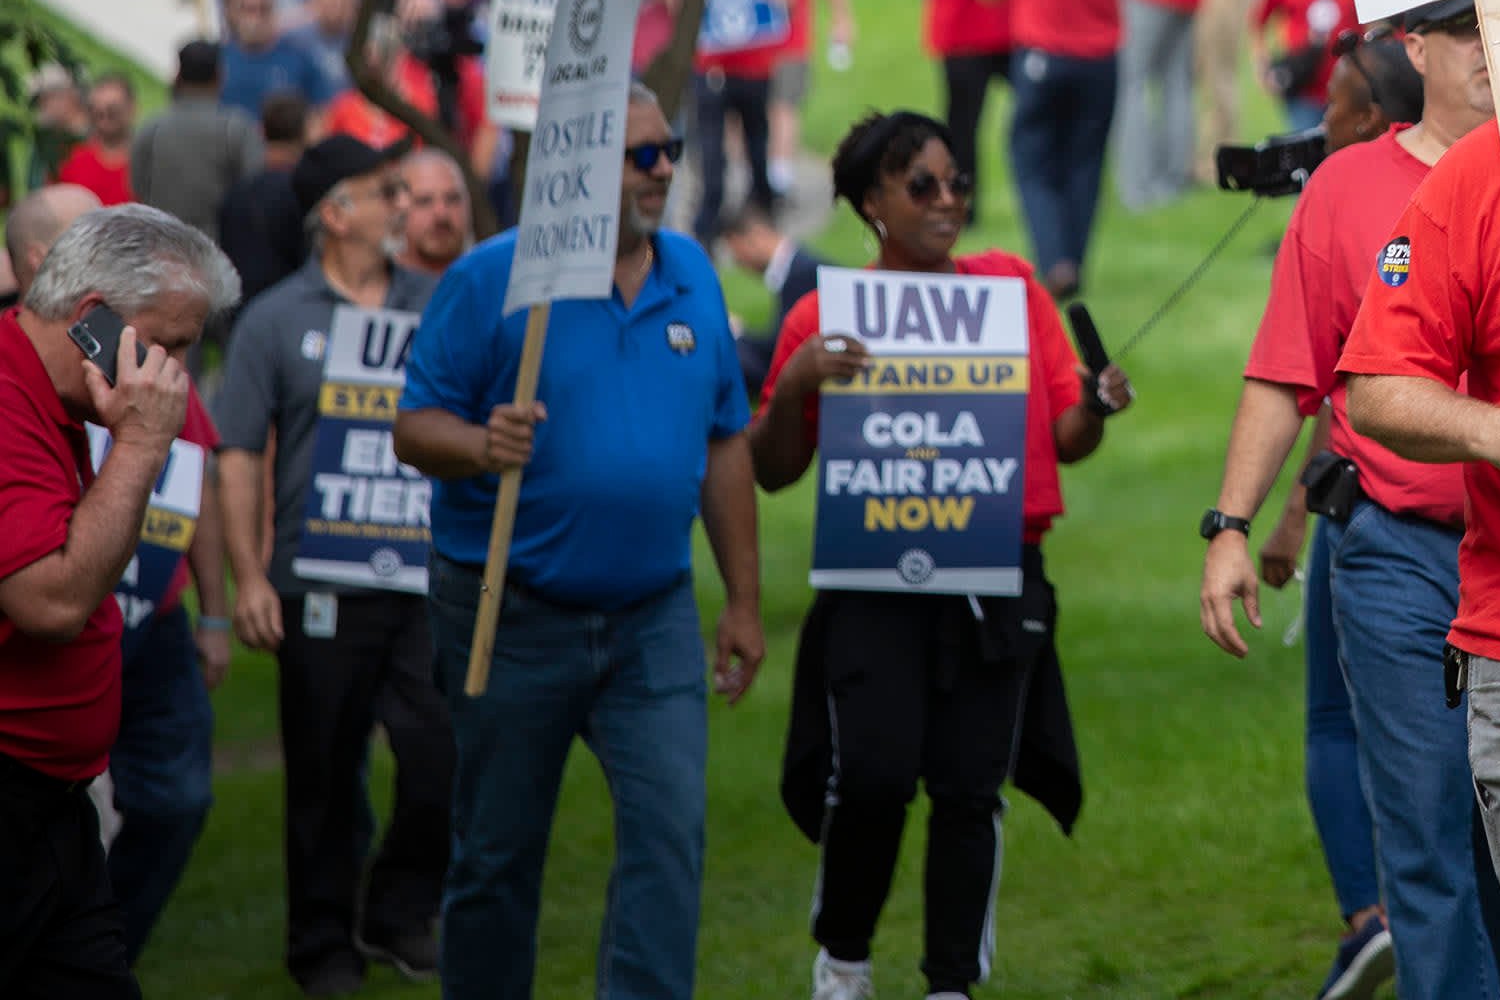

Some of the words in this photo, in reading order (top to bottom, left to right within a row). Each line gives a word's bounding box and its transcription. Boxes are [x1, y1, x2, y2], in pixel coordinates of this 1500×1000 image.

[854, 280, 989, 344] UAW
[362, 320, 417, 370] UA
[970, 362, 1014, 386] UP
[863, 411, 984, 448] COLA
[906, 449, 939, 460] AND
[825, 458, 927, 495] FAIR
[932, 457, 1018, 495] PAY
[316, 473, 432, 527] TIER
[864, 496, 974, 531] NOW
